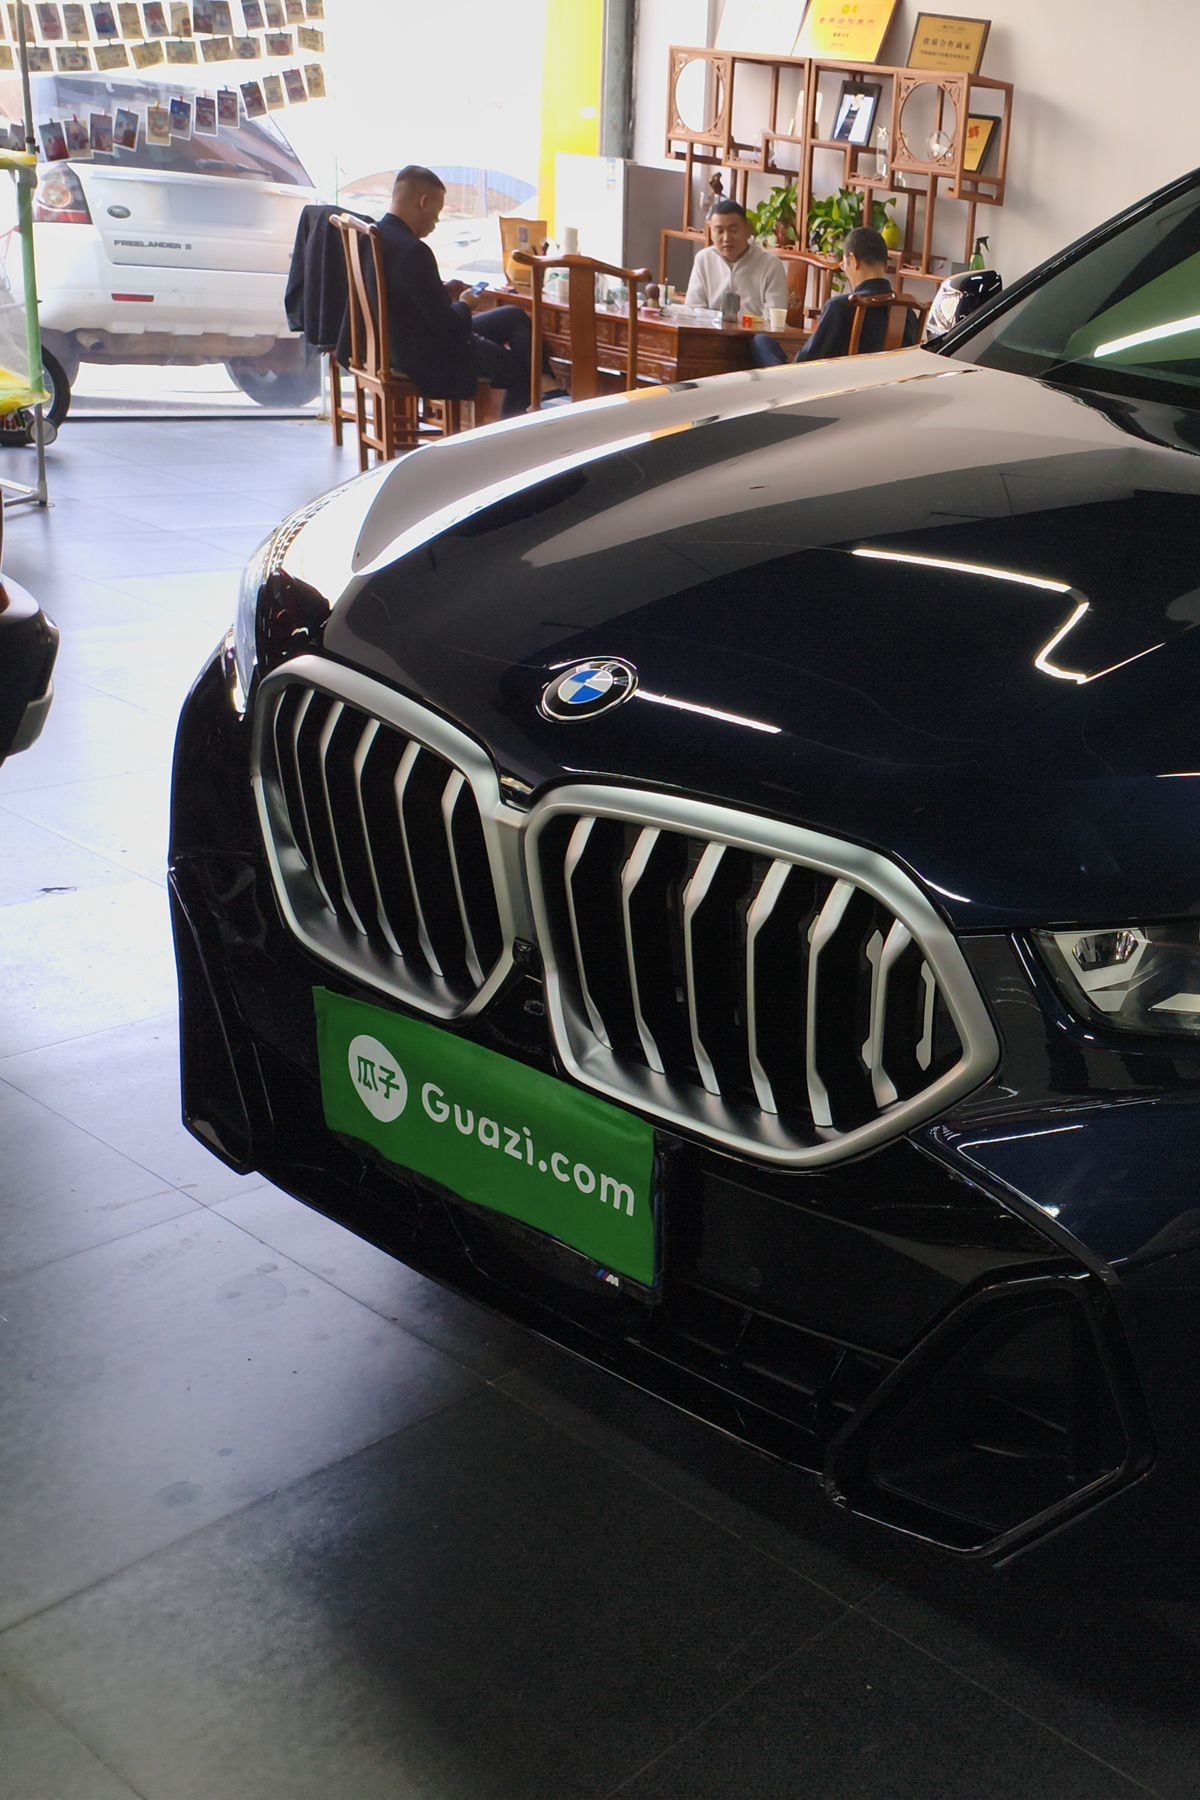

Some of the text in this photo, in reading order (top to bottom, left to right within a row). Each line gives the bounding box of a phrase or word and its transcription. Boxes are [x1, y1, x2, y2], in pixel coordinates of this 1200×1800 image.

[114, 240, 181, 249] FREELANDER
[357, 1055, 400, 1099] 瓜子
[421, 1082, 635, 1217] Guazi.com
